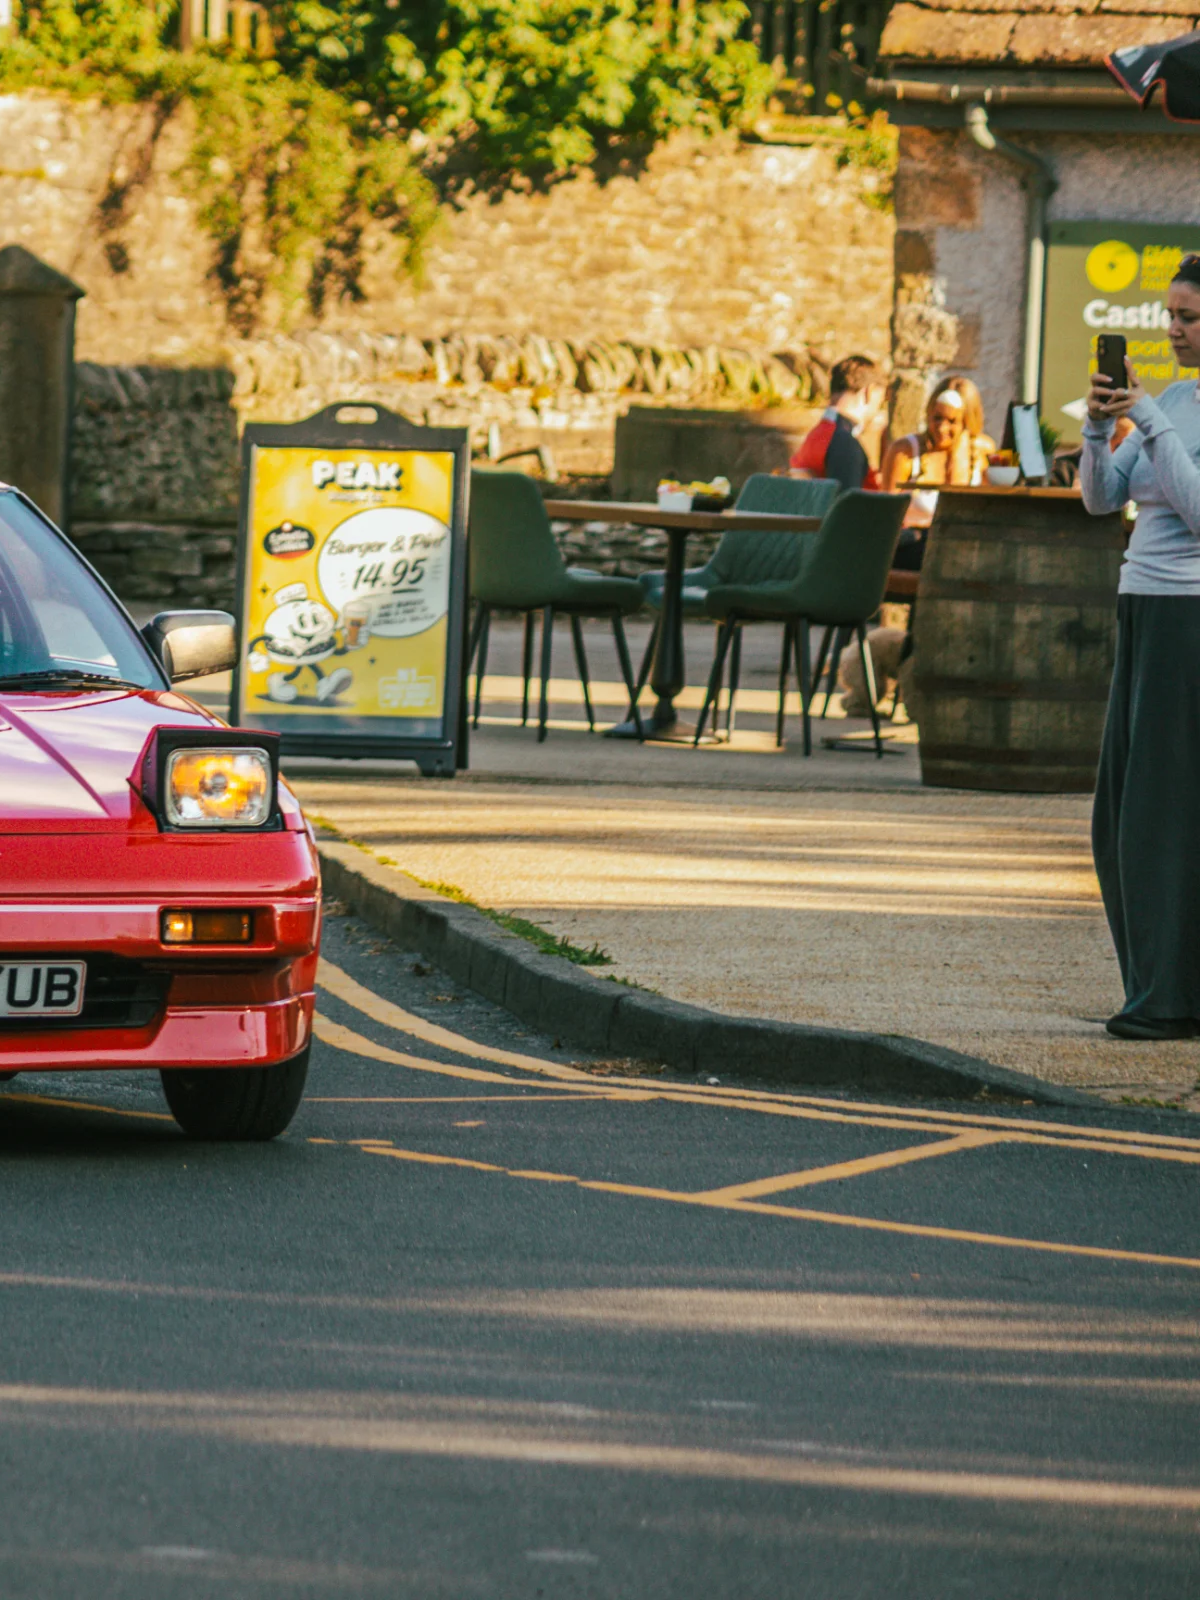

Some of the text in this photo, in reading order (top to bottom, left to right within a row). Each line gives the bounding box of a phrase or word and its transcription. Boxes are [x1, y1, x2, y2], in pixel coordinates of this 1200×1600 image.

[1089, 334, 1170, 357] Sport
[311, 460, 403, 491] PEAK
[326, 539, 388, 558] Burger
[390, 535, 405, 552] &
[352, 556, 428, 591] 14.95
